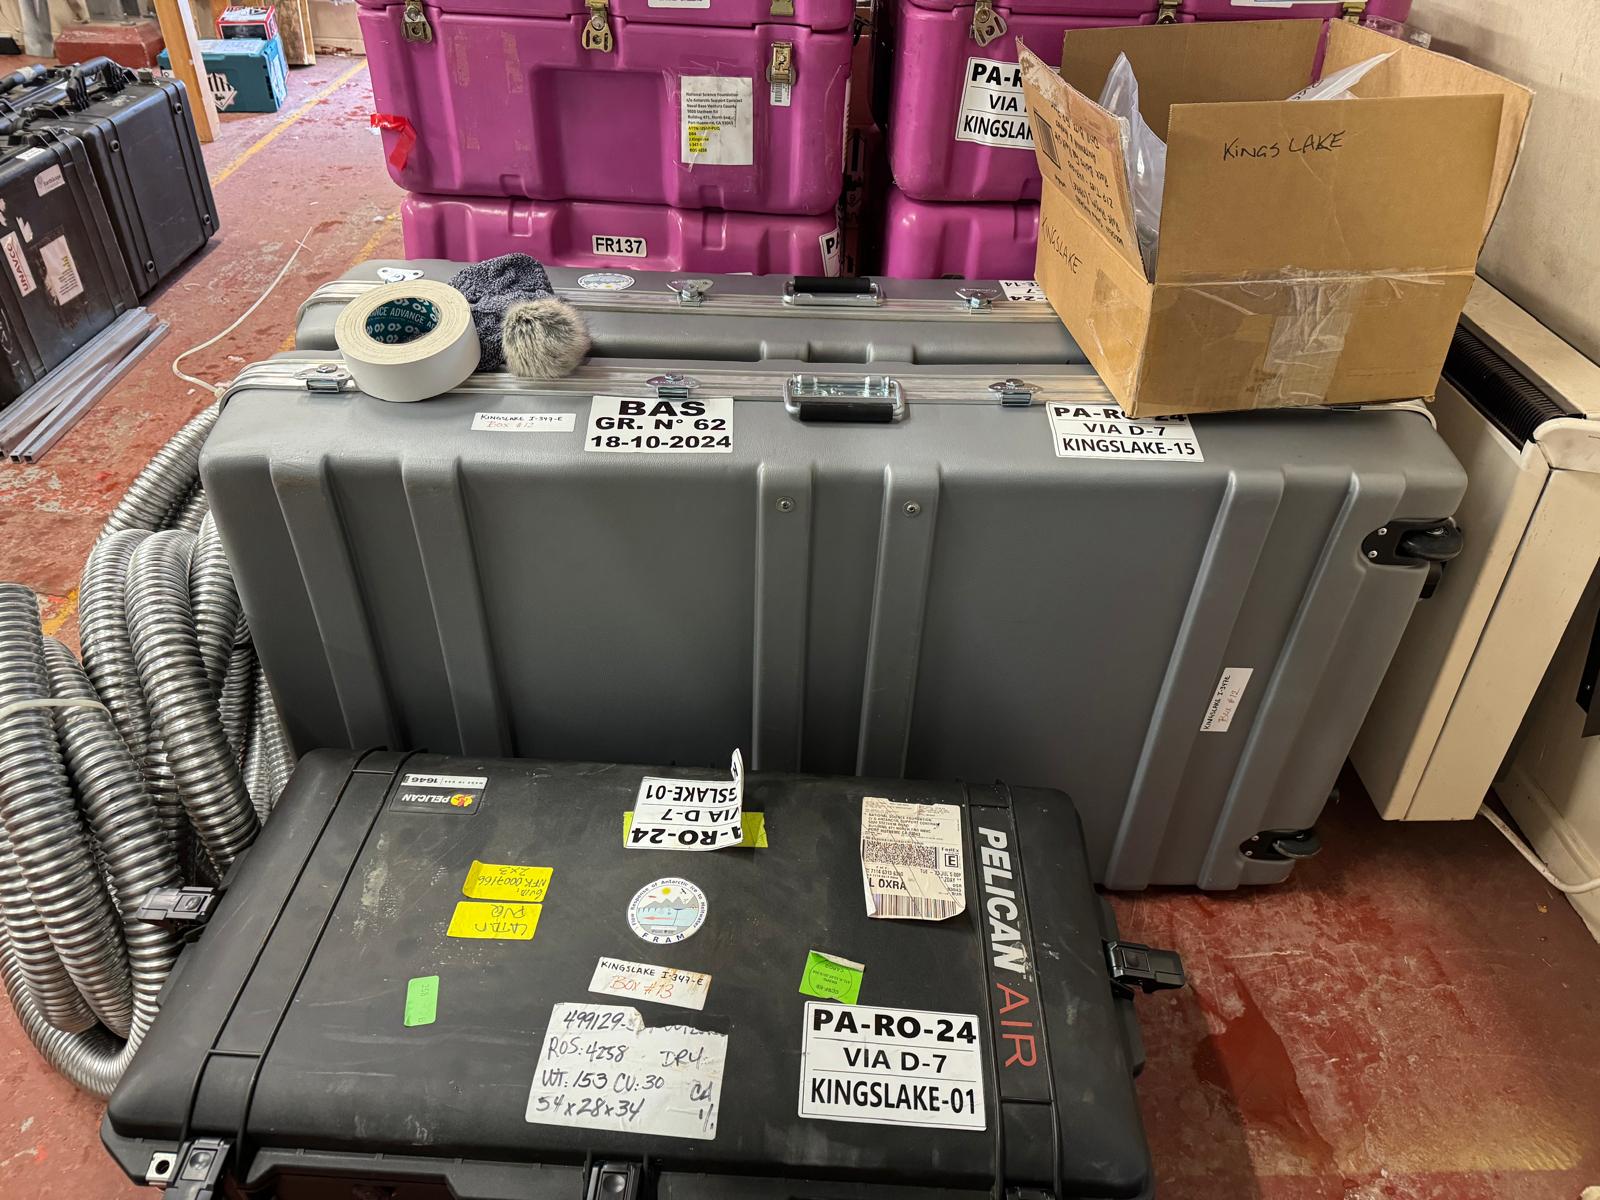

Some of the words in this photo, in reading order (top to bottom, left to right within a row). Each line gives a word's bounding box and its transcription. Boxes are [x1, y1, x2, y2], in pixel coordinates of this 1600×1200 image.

[989, 94, 1018, 111] VIA
[1289, 130, 1346, 154] LAKE
[595, 236, 643, 254] FR137
[389, 307, 426, 324] ADVANCE
[618, 399, 706, 417] BAS
[595, 416, 643, 431] GR.
[694, 418, 727, 431] 62
[1083, 423, 1122, 435] VIA
[1130, 425, 1166, 437] D-7
[590, 434, 732, 449] 18-10-2024
[1062, 437, 1196, 456] KINGSLAKE-15
[402, 793, 452, 804] PELICAN
[660, 809, 701, 822] D-7
[948, 855, 956, 866] E
[660, 878, 690, 888] Antarctic
[978, 826, 1028, 975] PELICAN
[641, 931, 686, 944] FRAM
[600, 961, 656, 976] KINGSLAKE
[660, 971, 705, 986] I-347-E
[813, 1008, 977, 1045] PA-RO-24
[996, 982, 1037, 1068] AIR
[586, 1041, 629, 1063] 4258
[842, 1046, 892, 1070] VIA
[901, 1051, 948, 1074] D-7
[572, 1069, 609, 1090] 153
[641, 1074, 665, 1091] 30
[811, 1077, 976, 1115] KINGSLAKE-01
